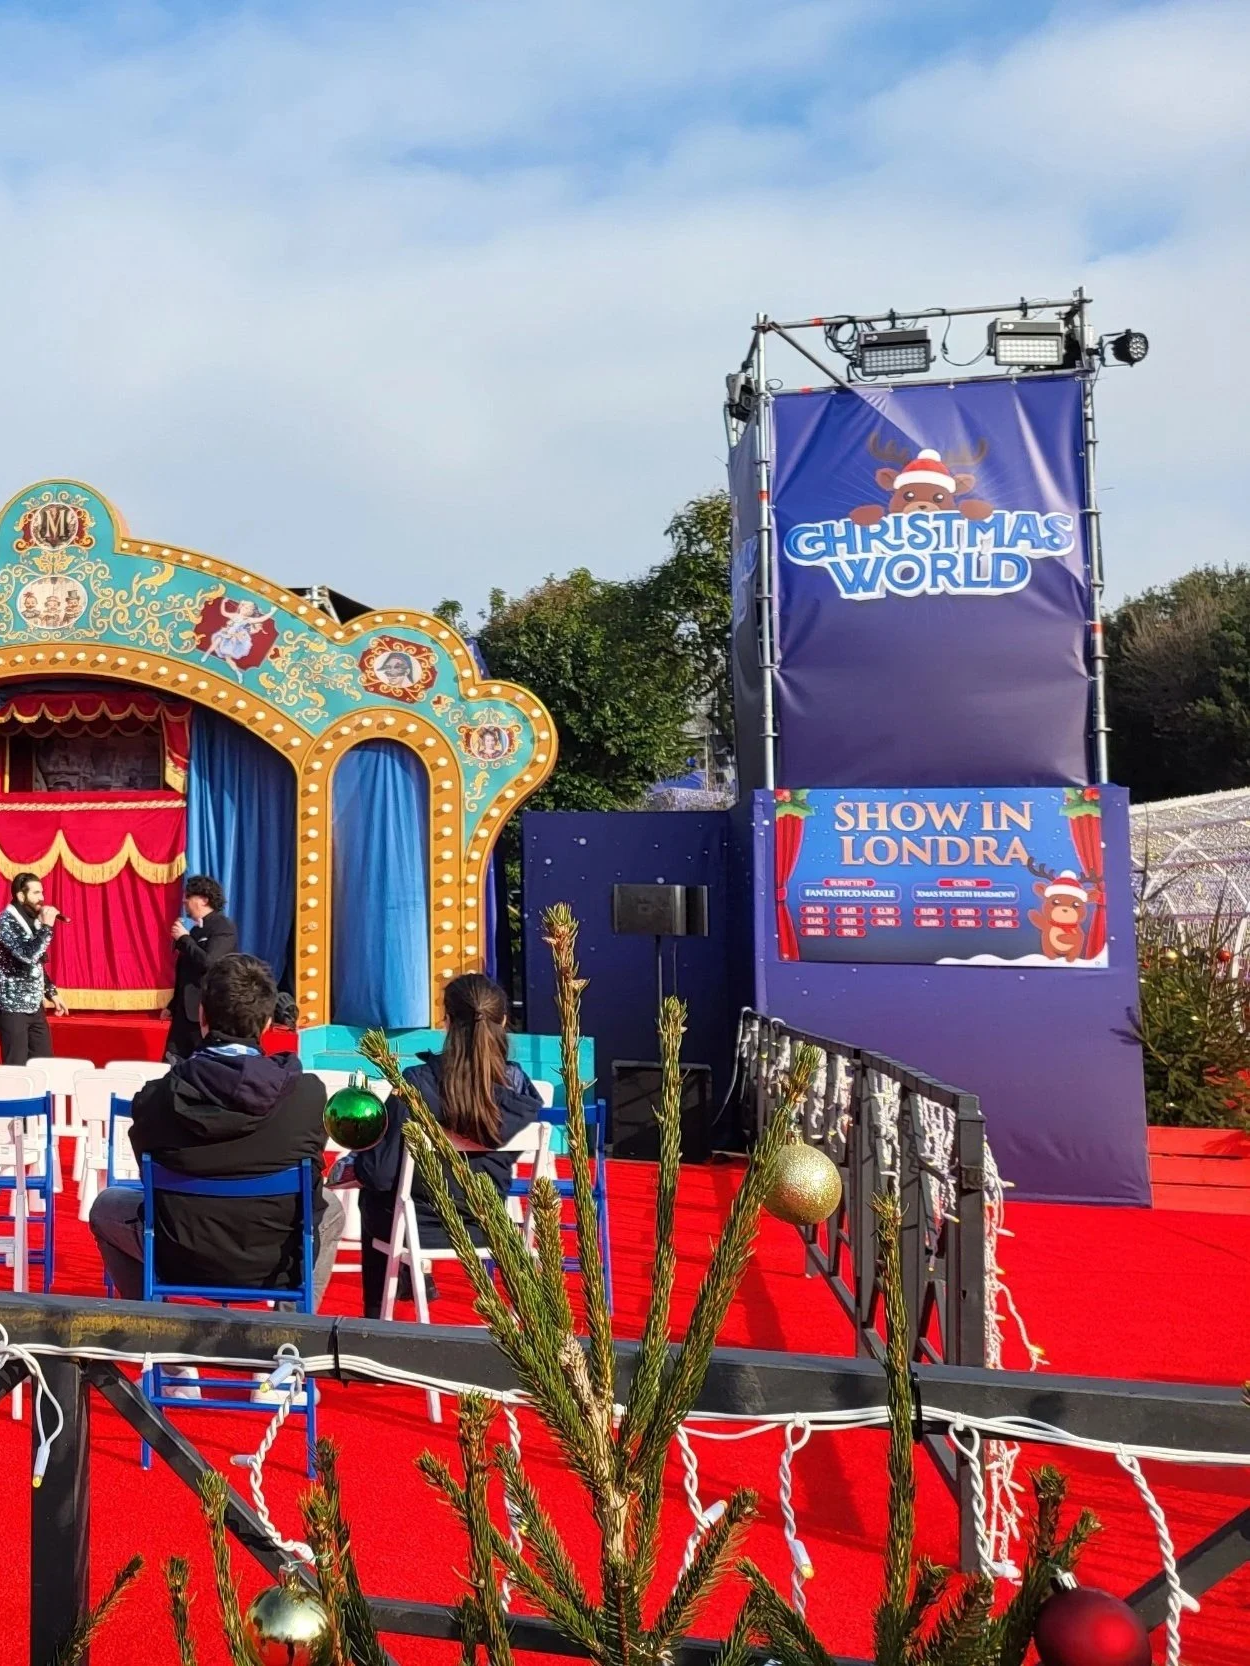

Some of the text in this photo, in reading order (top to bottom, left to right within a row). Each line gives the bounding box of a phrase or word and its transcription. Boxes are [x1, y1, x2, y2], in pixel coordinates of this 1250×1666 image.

[784, 511, 1074, 564] CHRISTMAS
[828, 551, 1029, 597] WORLD
[834, 801, 1034, 832] SHOW IN
[839, 836, 1031, 866] LONDRA
[804, 888, 896, 898] FANTASTICO NATALE
[916, 890, 1016, 898] XMAS FOURTH HARMONY
